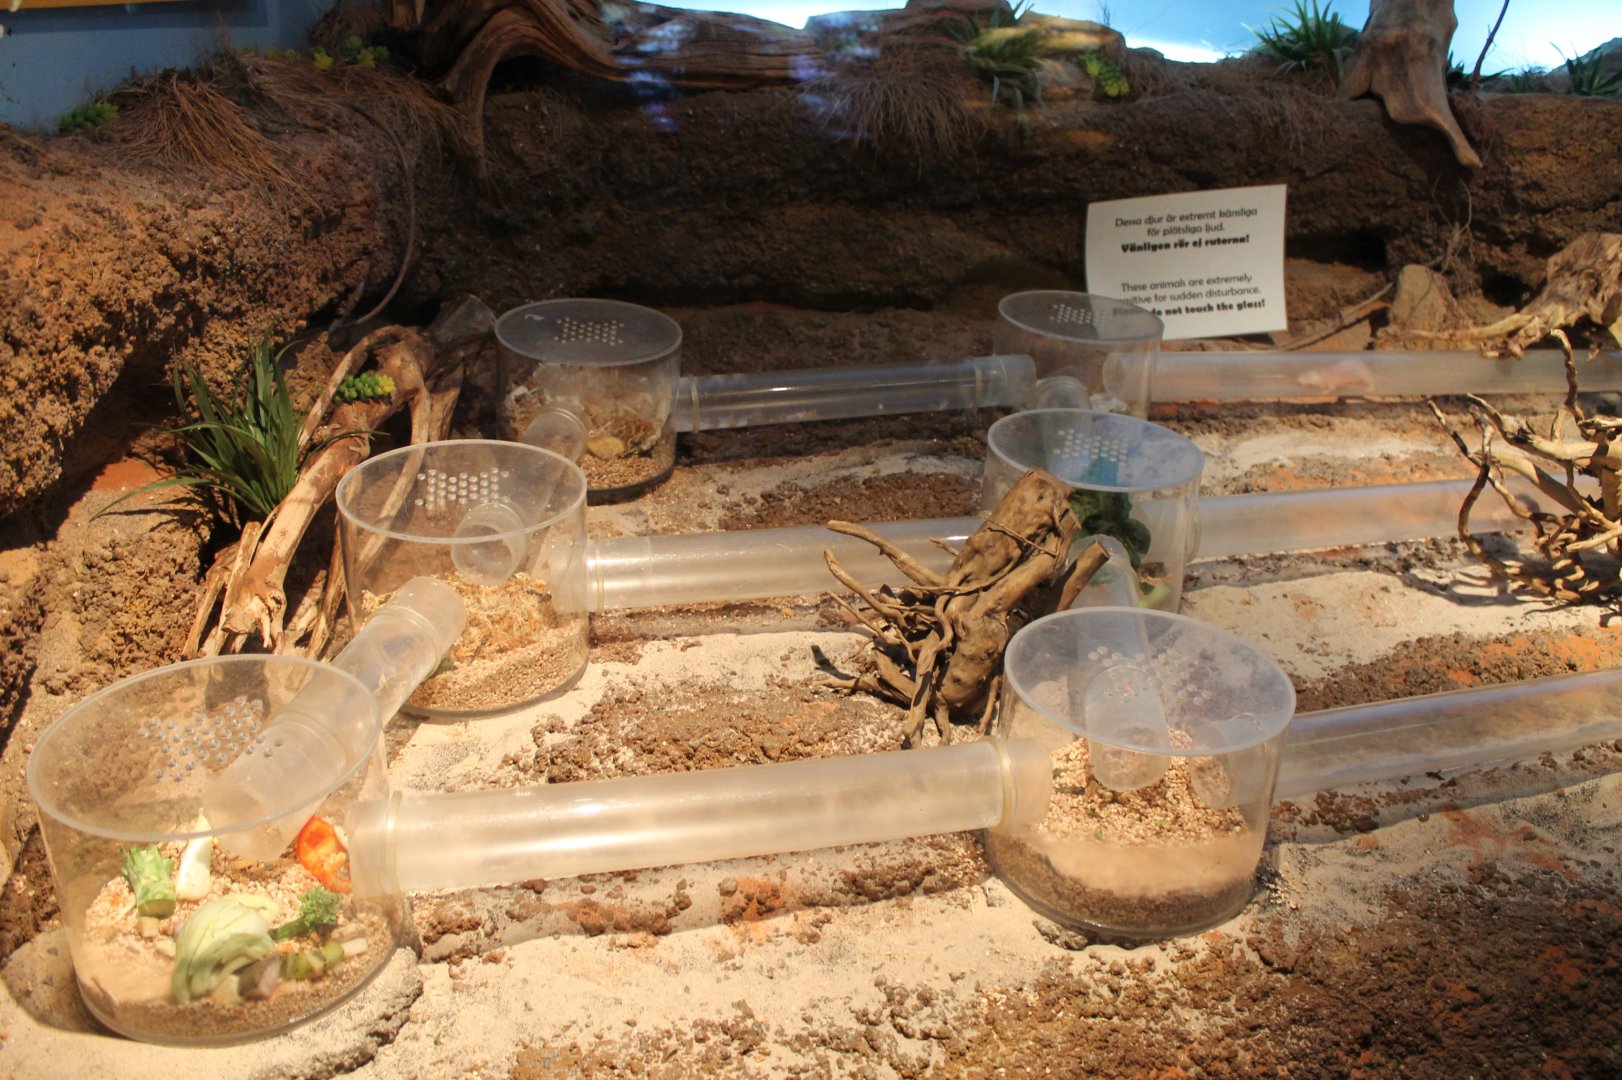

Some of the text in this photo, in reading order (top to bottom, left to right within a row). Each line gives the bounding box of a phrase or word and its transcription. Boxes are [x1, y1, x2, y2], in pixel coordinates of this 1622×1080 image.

[1115, 208, 1258, 228] Dessa djur är extremt känsliga
[1147, 222, 1225, 237] för plötsliga ljud.
[1121, 242, 1170, 253] Vänligen
[1174, 240, 1189, 248] rör
[1192, 238, 1202, 248] ej
[1121, 273, 1252, 292] These animals are extremely
[1154, 294, 1168, 303] for
[1170, 290, 1203, 302] sudden
[1206, 286, 1261, 299] disturbance.
[1165, 306, 1182, 316] not
[1185, 303, 1214, 314] touch
[1216, 301, 1234, 311] the
[1237, 299, 1266, 311] glass!
